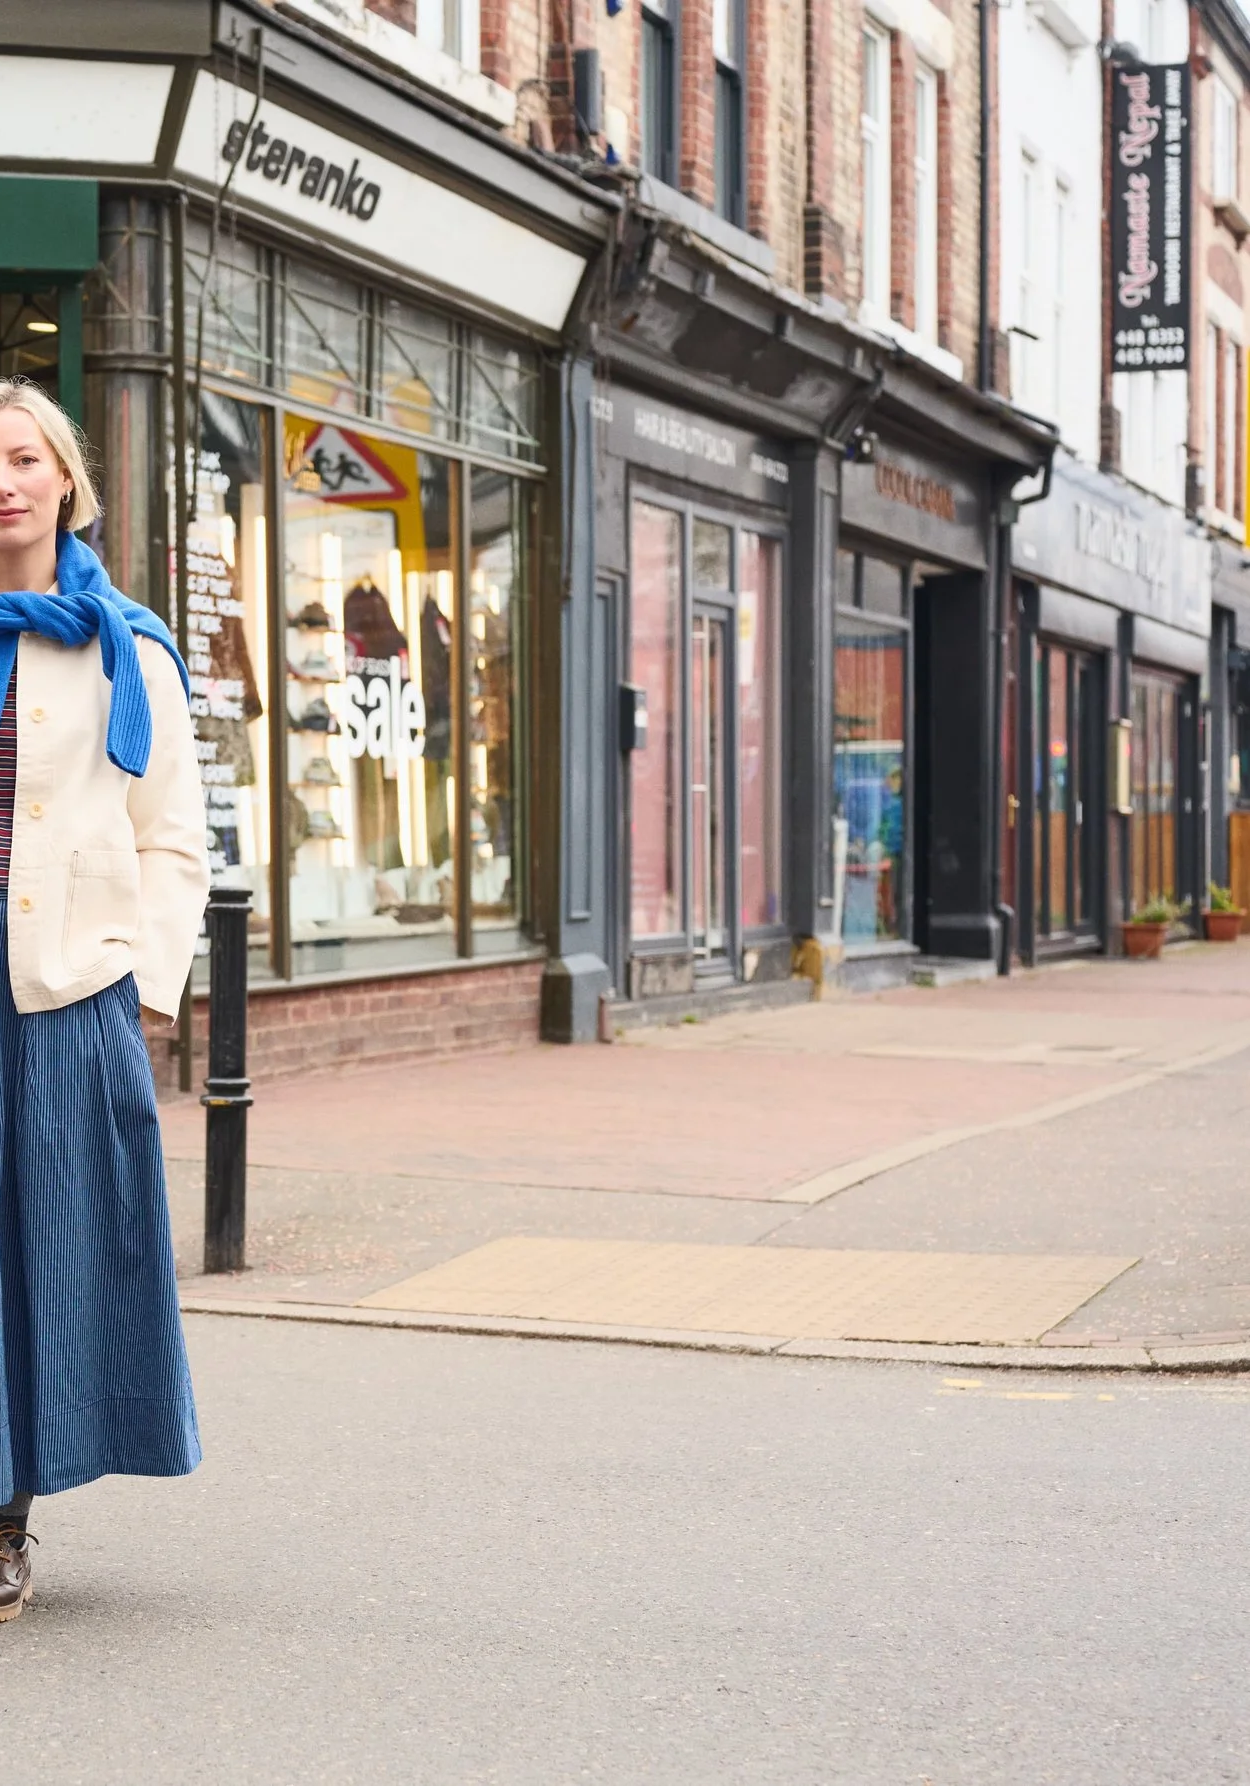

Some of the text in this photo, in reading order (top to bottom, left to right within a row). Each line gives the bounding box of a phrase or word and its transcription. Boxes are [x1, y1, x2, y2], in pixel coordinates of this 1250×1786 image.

[221, 116, 383, 223] steranko
[1118, 71, 1162, 309] Namaste Nepal
[1163, 155, 1182, 238] RESTAURANT
[1163, 238, 1182, 307] TANDOORI
[346, 655, 428, 761] sale
